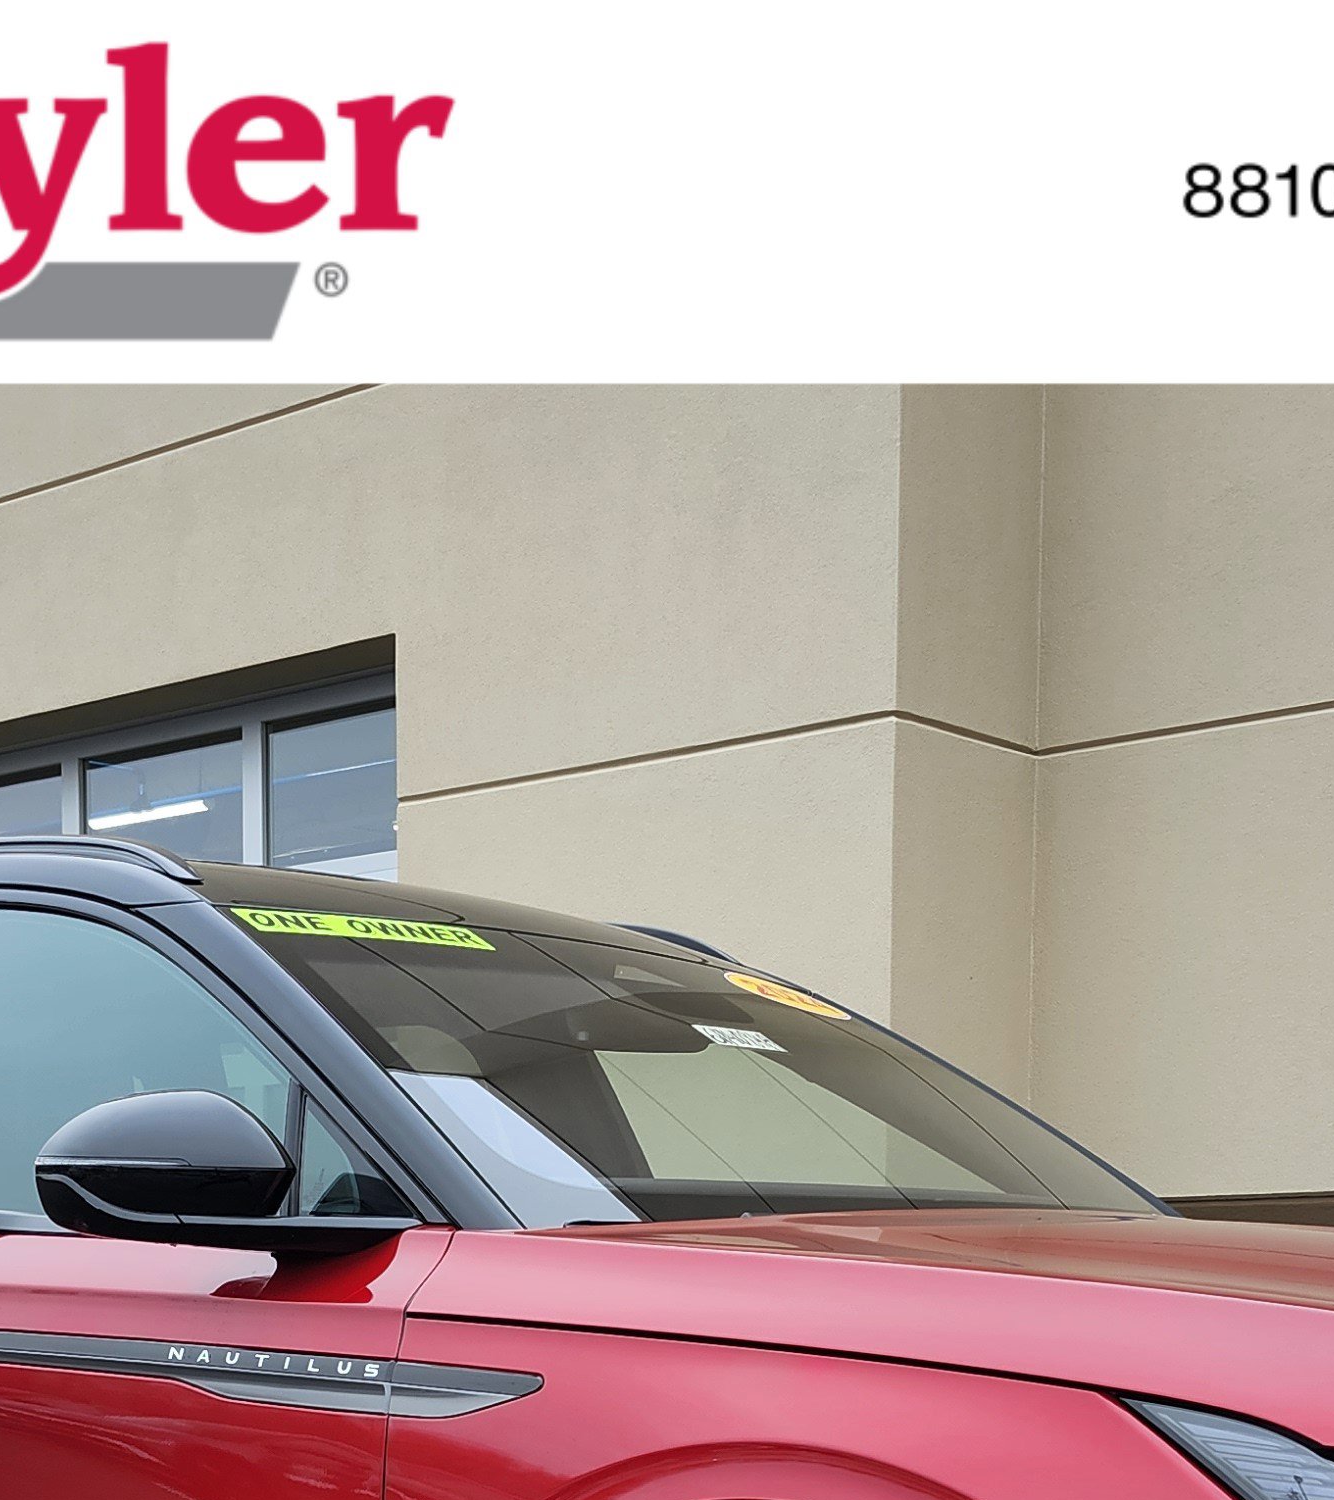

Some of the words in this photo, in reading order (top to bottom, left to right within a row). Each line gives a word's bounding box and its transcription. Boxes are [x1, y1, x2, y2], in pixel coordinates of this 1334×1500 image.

[248, 911, 333, 931] ONE
[346, 918, 479, 945] OWNER
[167, 1346, 380, 1378] NAUTILUS
